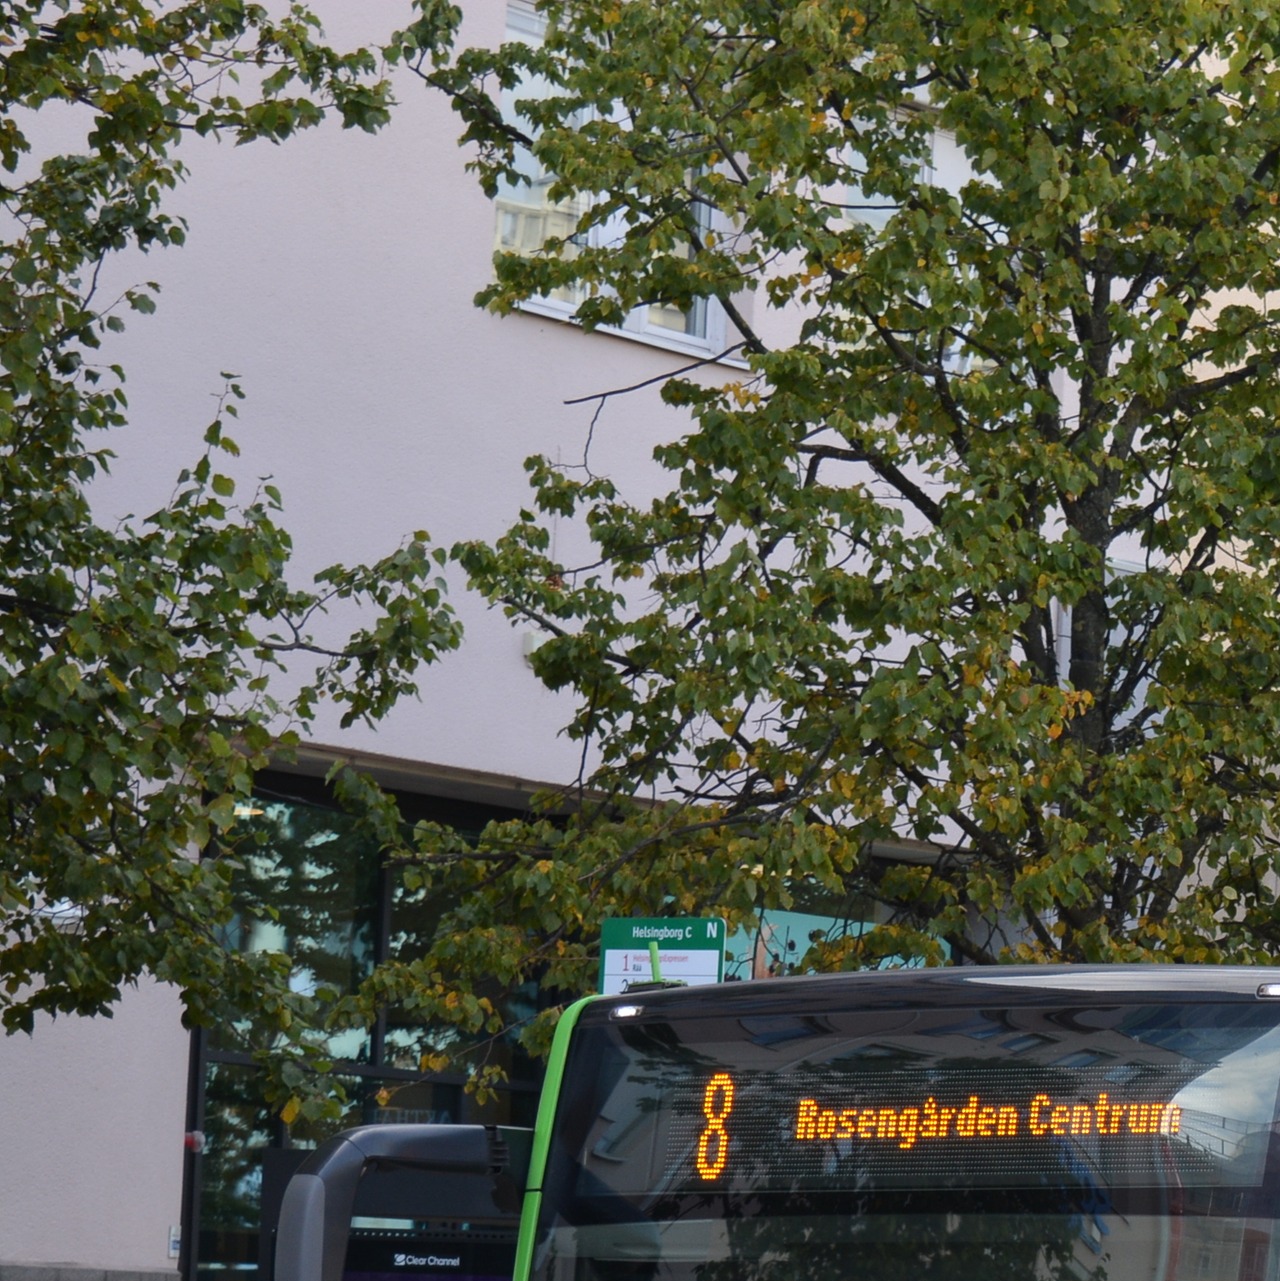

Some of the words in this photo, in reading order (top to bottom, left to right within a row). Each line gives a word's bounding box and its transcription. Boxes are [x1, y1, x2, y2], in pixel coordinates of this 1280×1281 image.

[632, 926, 684, 940] Helsingborg
[685, 926, 693, 938] C
[706, 922, 718, 938] N
[622, 954, 630, 972] 1
[697, 1073, 734, 1180] 8
[796, 1096, 1018, 1149] Rosengården
[1028, 1093, 1181, 1135] Centrum
[406, 1255, 427, 1265] Clear
[428, 1256, 460, 1267] Channel
